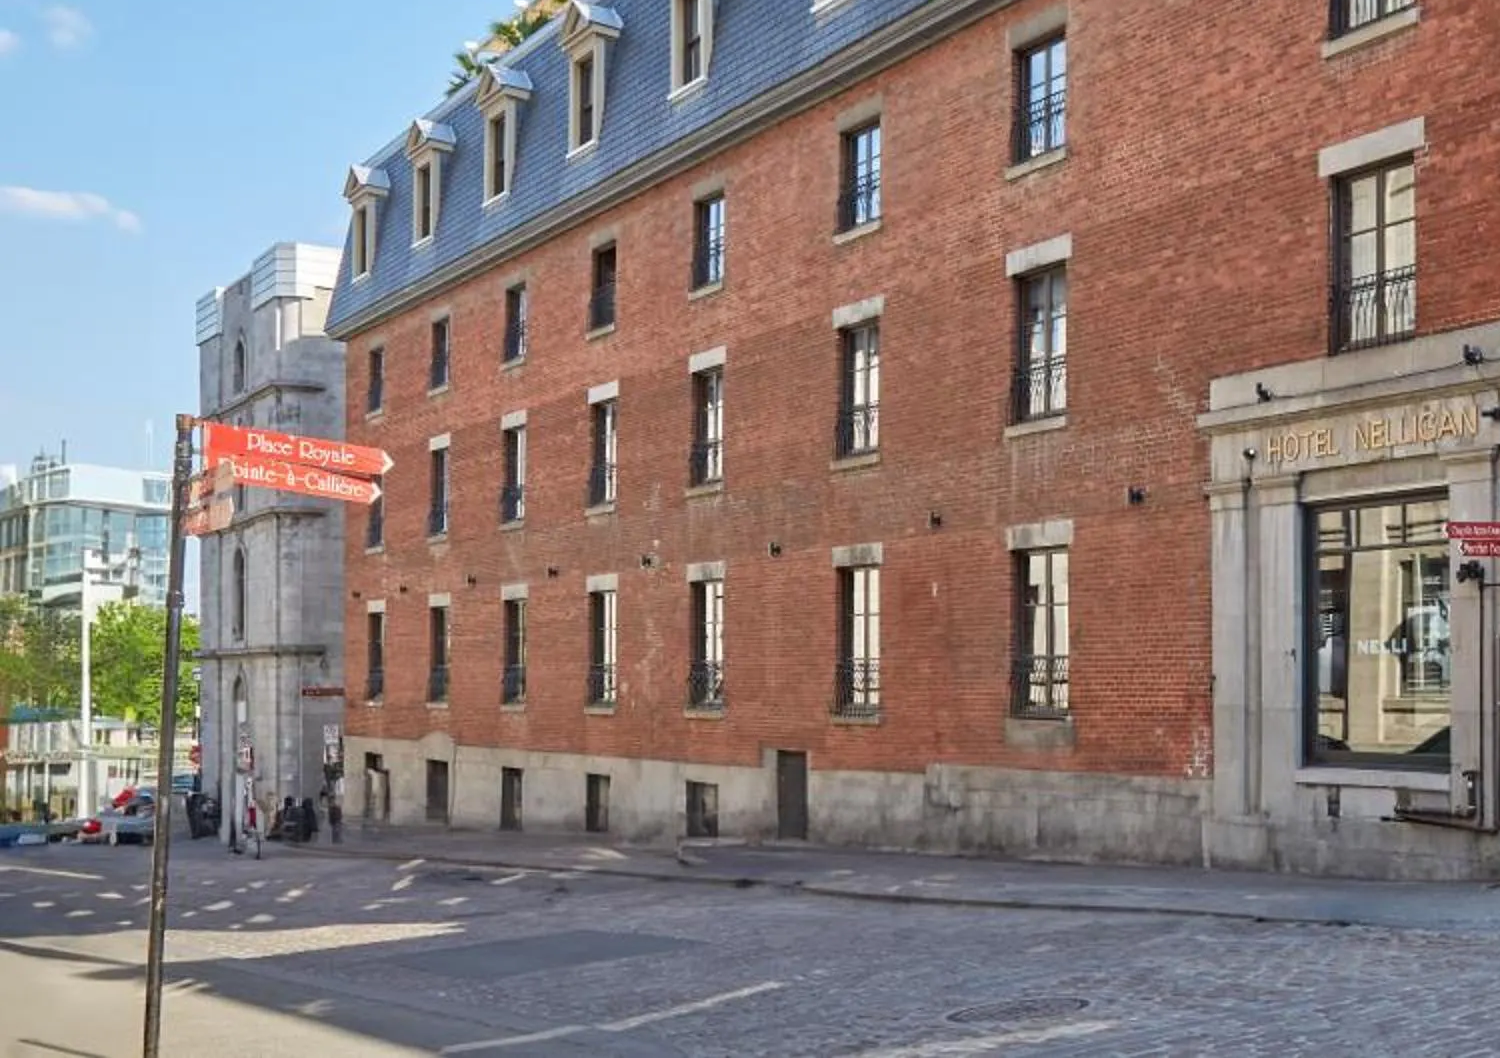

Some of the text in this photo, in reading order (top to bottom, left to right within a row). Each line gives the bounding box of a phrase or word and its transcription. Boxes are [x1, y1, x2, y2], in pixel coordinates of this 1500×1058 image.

[247, 433, 355, 467] Place Royale
[1267, 404, 1478, 463] HOTEL NELLIGAN
